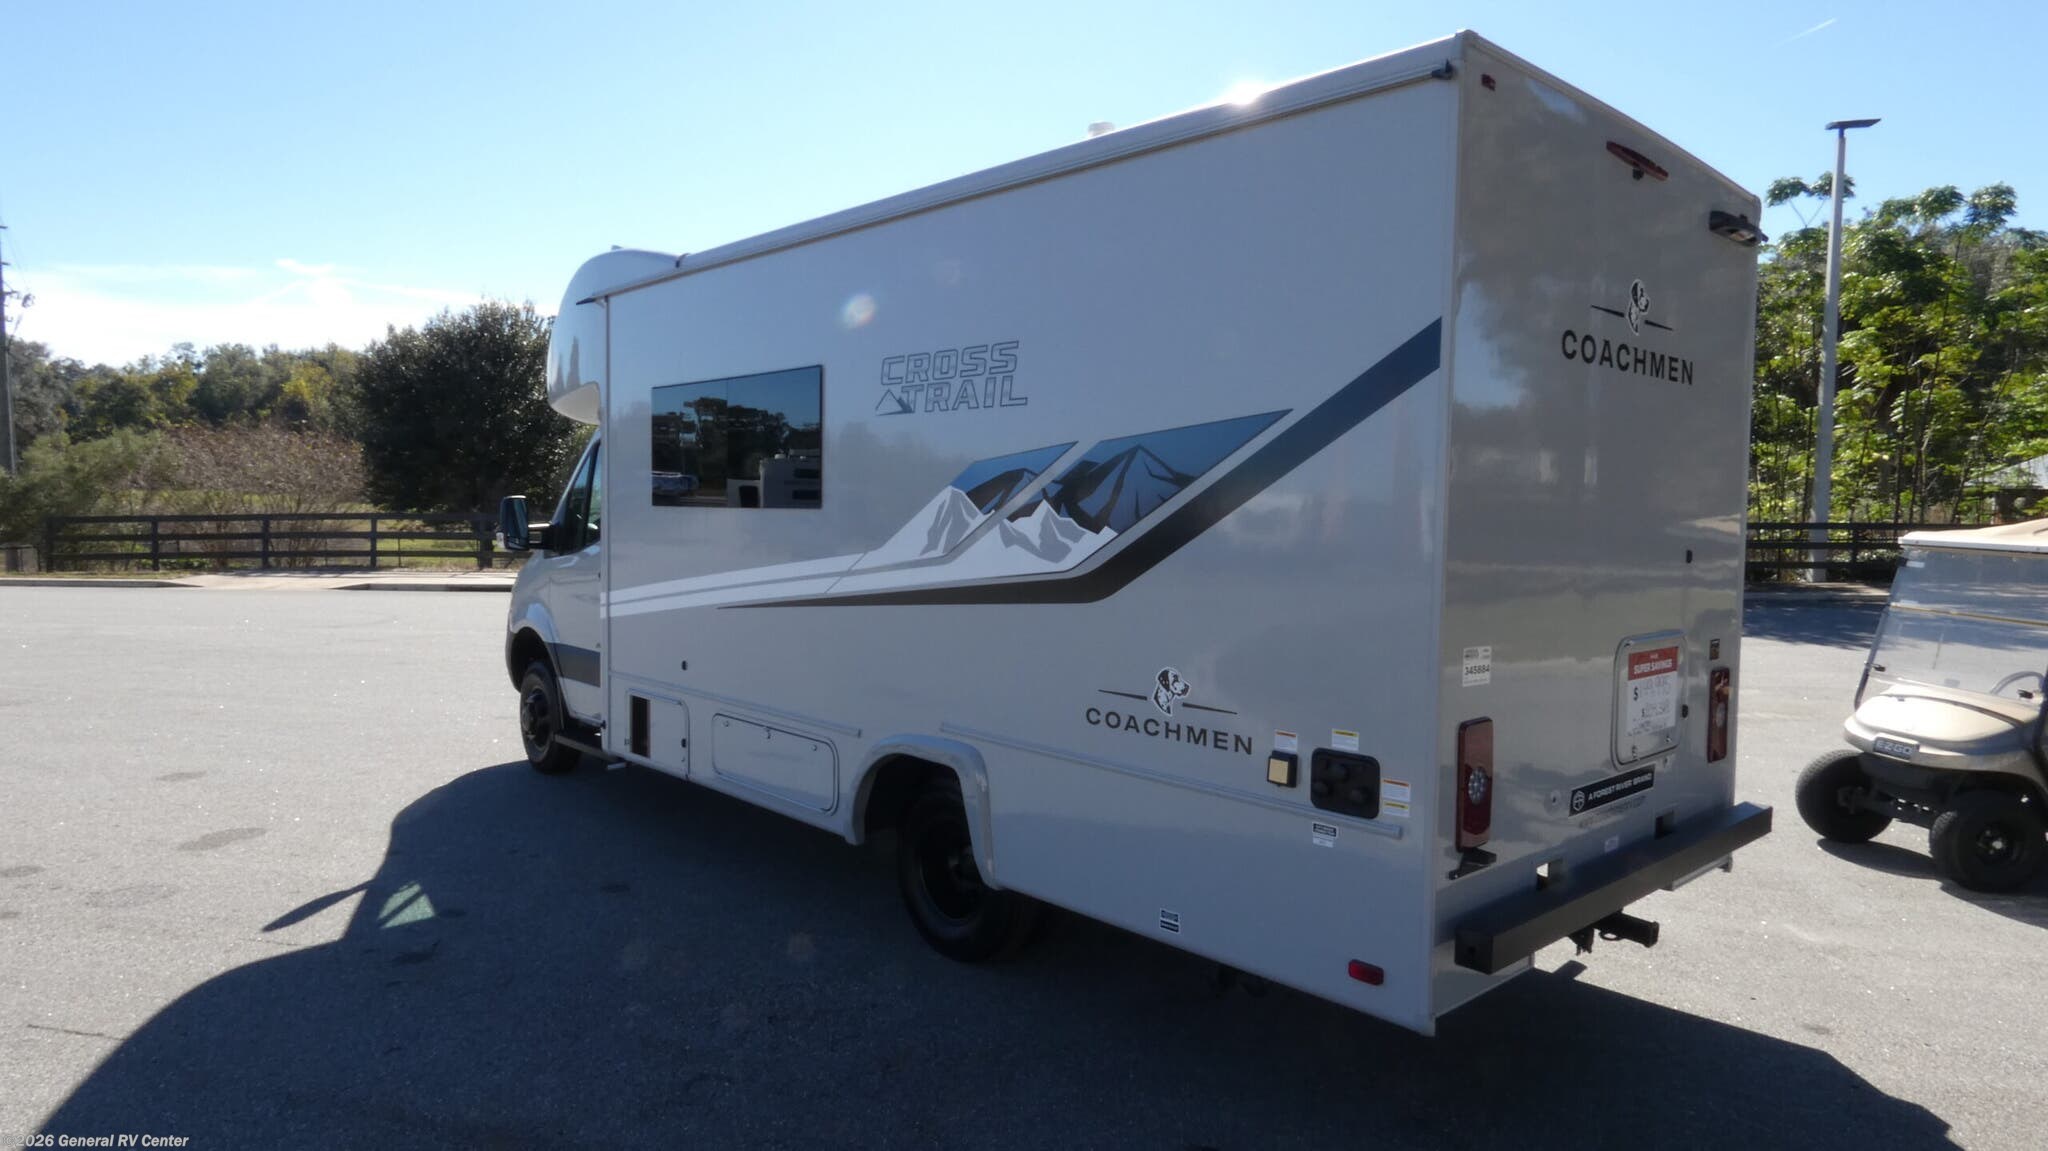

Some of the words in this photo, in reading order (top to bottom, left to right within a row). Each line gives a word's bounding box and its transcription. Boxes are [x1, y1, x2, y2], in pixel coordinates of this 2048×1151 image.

[881, 340, 1020, 386] CROSS
[1562, 329, 1694, 386] COACHMEN
[901, 375, 1028, 413] TRAIL
[1086, 707, 1253, 755] COACHMEN
[1588, 792, 1593, 801] A
[1593, 785, 1615, 799] FOREST
